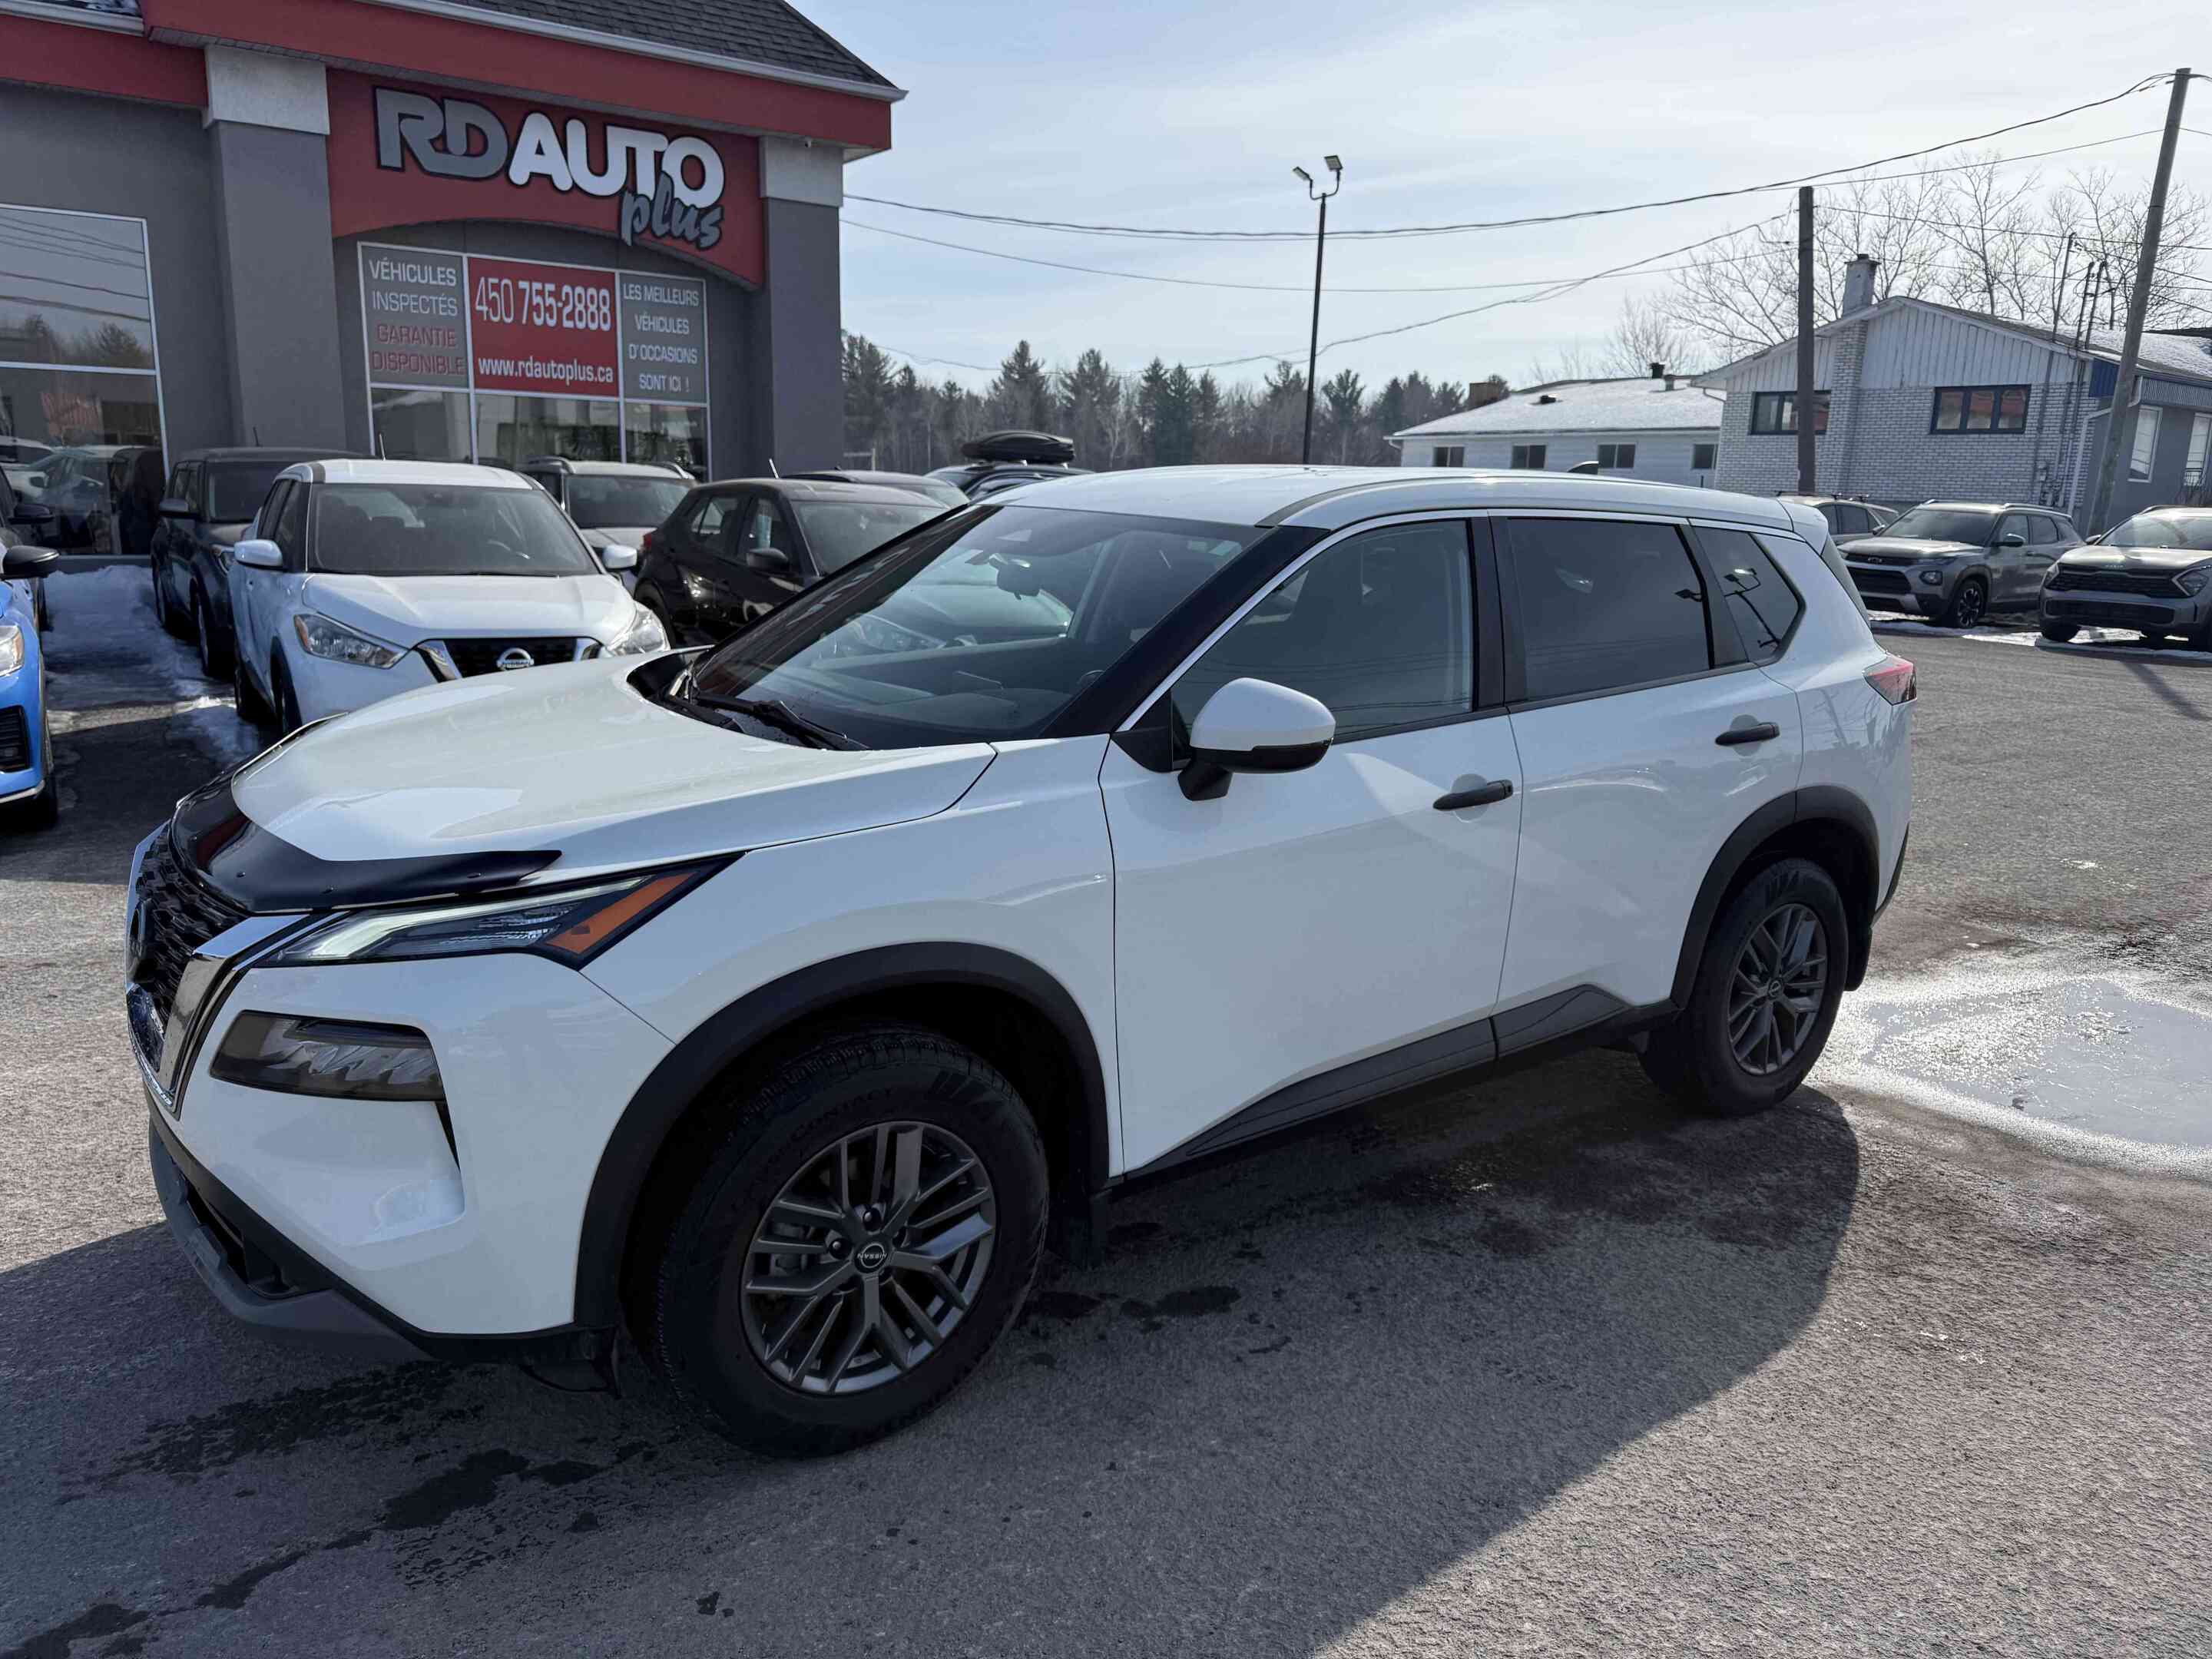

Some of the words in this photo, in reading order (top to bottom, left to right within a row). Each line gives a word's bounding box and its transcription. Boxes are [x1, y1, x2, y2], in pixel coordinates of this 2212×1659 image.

[619, 169, 724, 250] plus
[369, 257, 457, 286] VÉHICULES
[373, 290, 459, 316] INSPECTÉS
[475, 276, 515, 323] 450
[518, 280, 612, 332] 755-2888
[622, 283, 642, 300] LES
[644, 285, 700, 307] MEILLEURS
[634, 310, 690, 335] VÉHICULES
[376, 323, 456, 349] GARANTIE
[369, 350, 465, 376] DISPONIBLE
[478, 355, 614, 386] www.rdautoplus.ca
[638, 373, 667, 391] SONT
[668, 374, 682, 392] ICI
